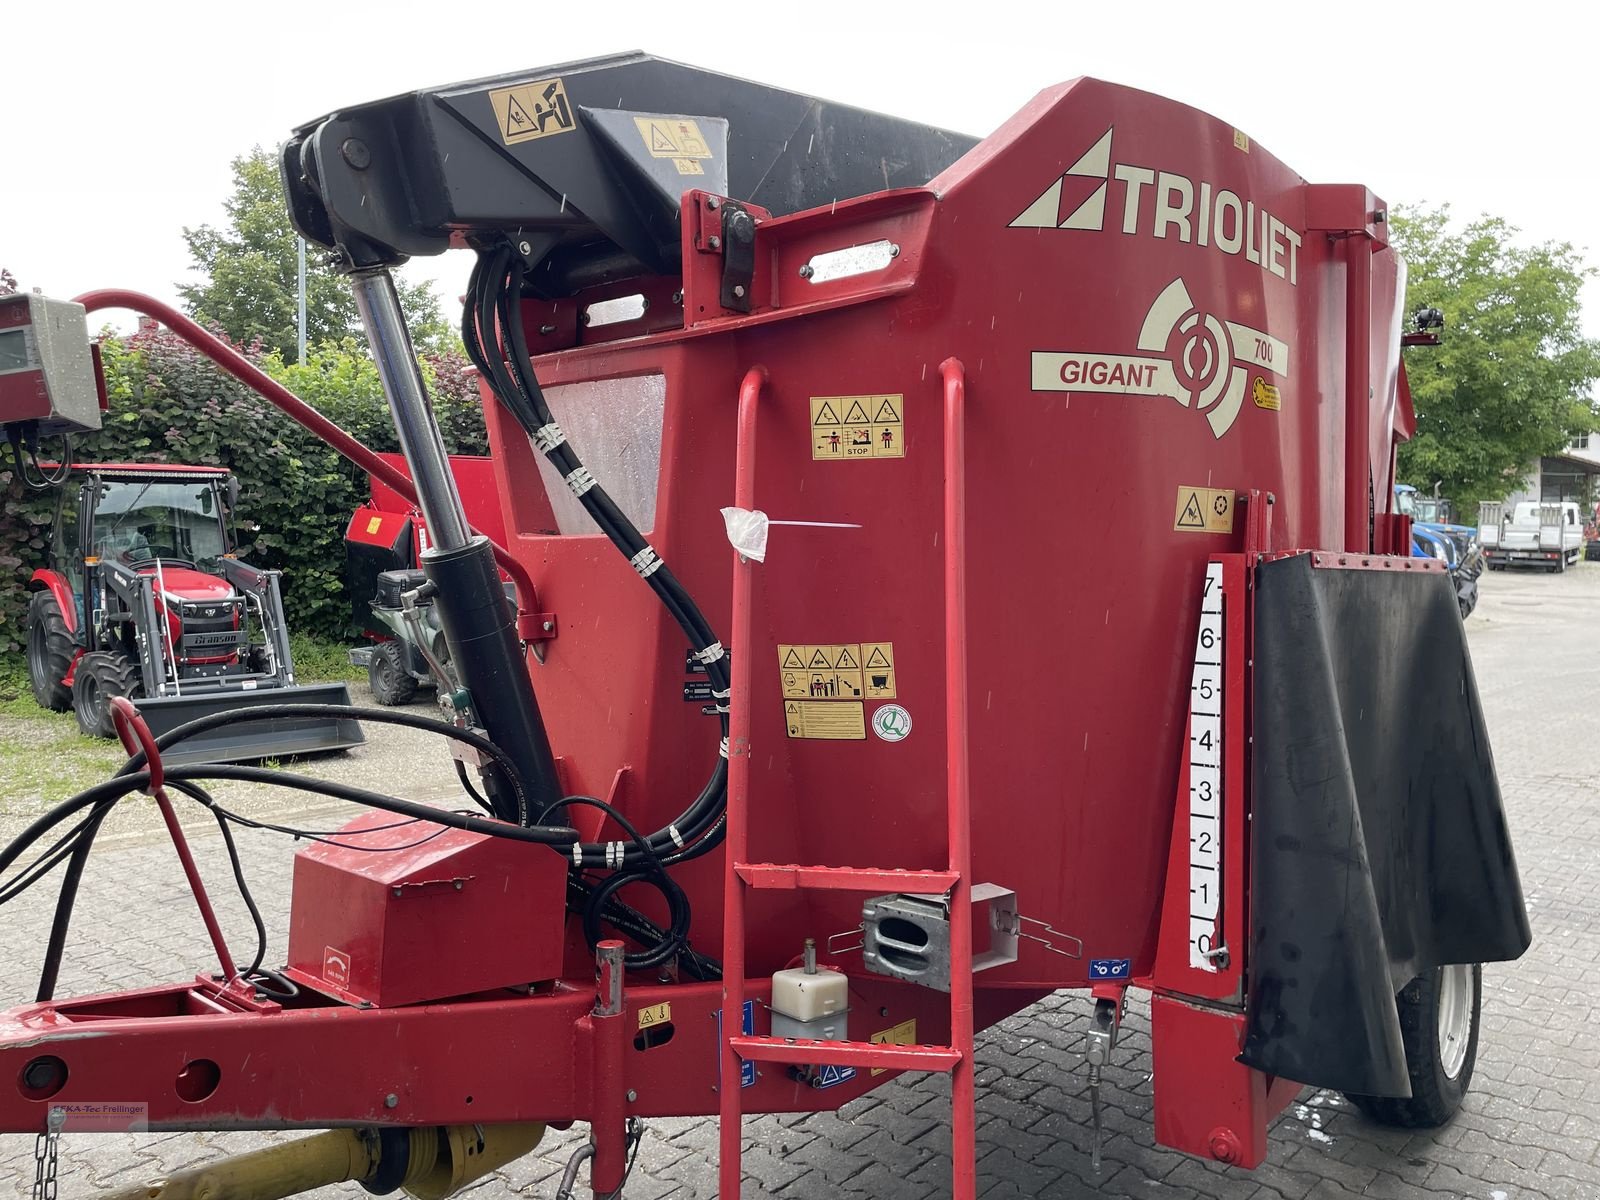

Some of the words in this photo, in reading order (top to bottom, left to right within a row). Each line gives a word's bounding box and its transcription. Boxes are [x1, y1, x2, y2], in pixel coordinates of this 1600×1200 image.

[1114, 164, 1302, 285] TRIOLIET
[1254, 338, 1273, 363] 700
[1060, 360, 1158, 388] GIGANT
[1203, 576, 1215, 598] 7
[194, 635, 237, 645] Branson
[1200, 628, 1214, 649] 6
[1199, 678, 1213, 700] 5
[1198, 729, 1213, 751] 4
[1198, 781, 1212, 802] 3
[1198, 831, 1212, 853] 2
[1199, 883, 1208, 904] 1
[1197, 933, 1212, 955] 0
